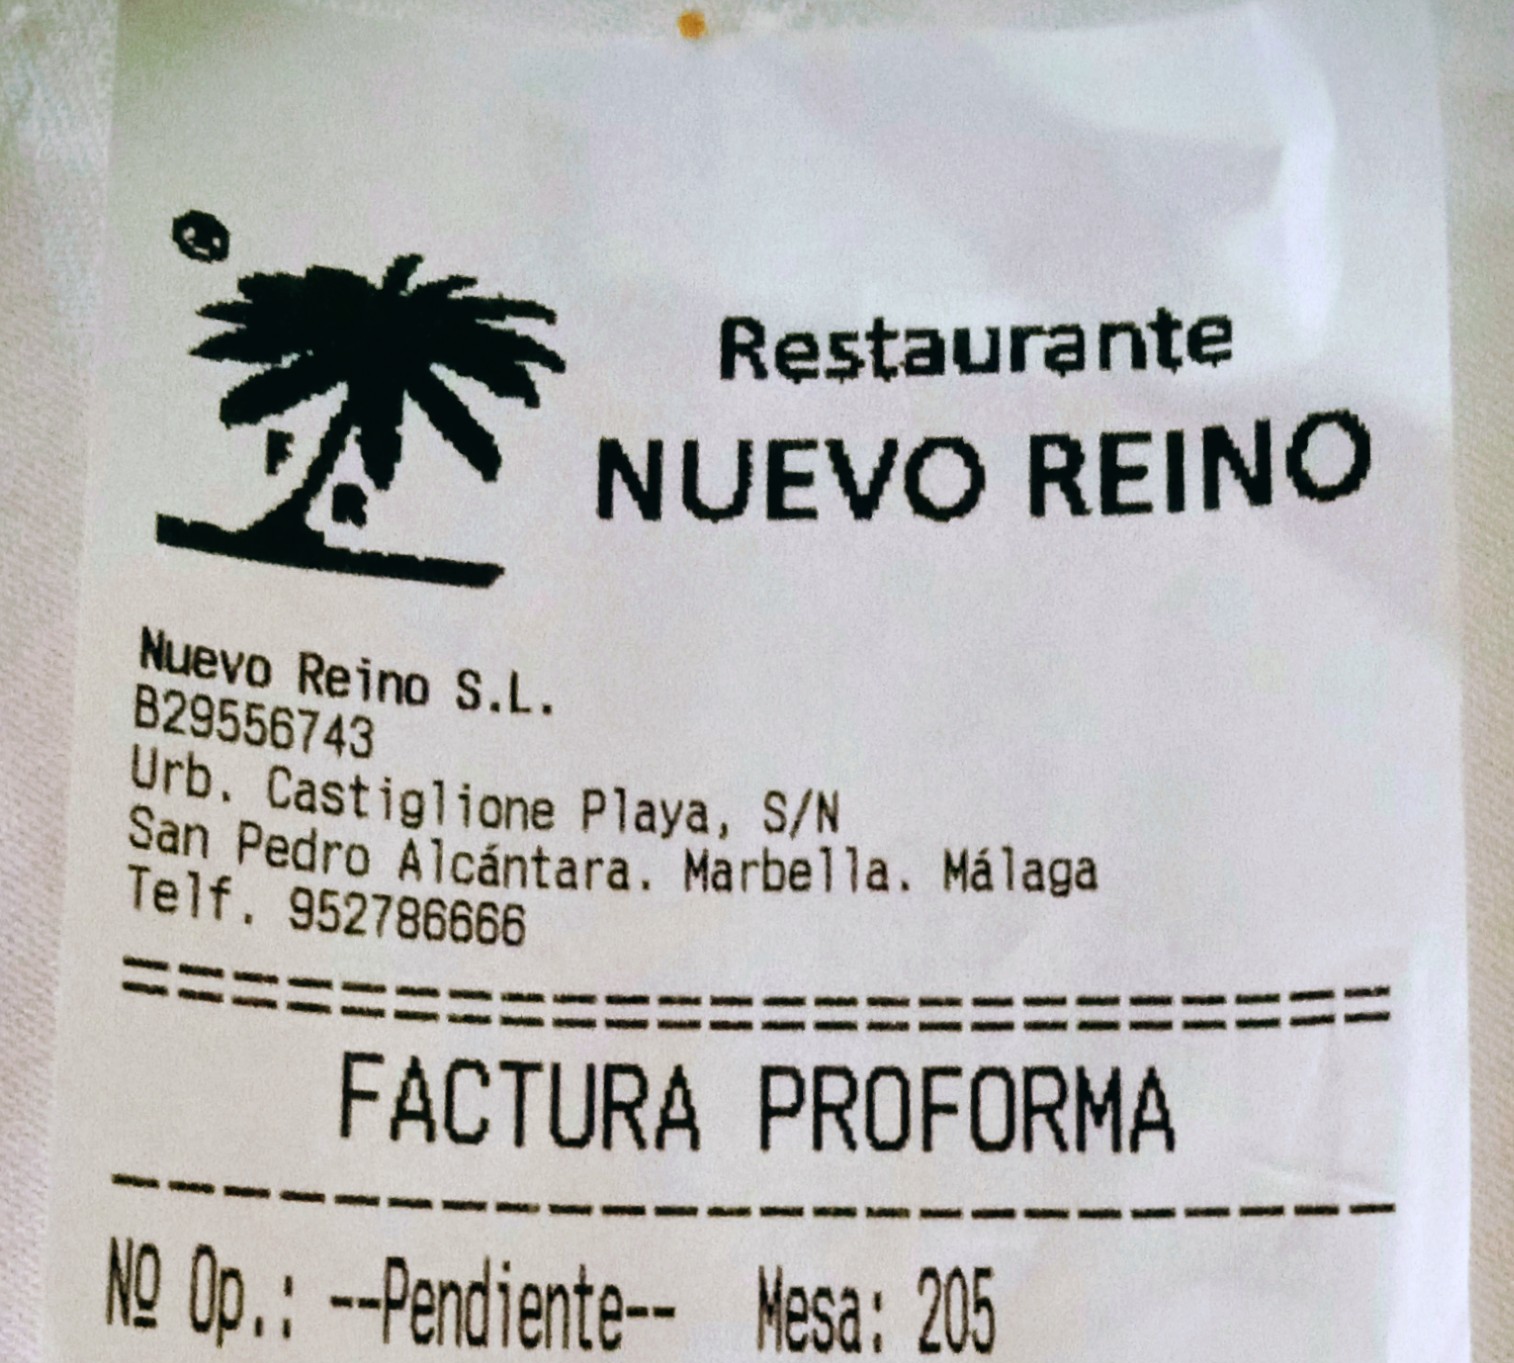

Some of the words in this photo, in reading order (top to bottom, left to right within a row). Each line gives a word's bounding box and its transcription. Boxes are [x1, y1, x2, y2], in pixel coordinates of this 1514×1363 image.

[718, 305, 1234, 386] Restaurante
[594, 434, 988, 526] NUEVO
[1027, 407, 1373, 520] REINO
[138, 624, 273, 690] Nuevo
[297, 650, 431, 708] Reino
[454, 667, 553, 717] S.L.
[133, 682, 375, 760] B29556743
[130, 742, 232, 803] Urb.
[266, 763, 556, 832] Castiglione
[581, 785, 729, 841] Playa,
[762, 787, 840, 841] S/N
[127, 803, 210, 860] San
[236, 818, 372, 878] Pedro
[397, 836, 651, 892] Alcántara.
[683, 844, 911, 894] Marbella.
[942, 844, 1100, 899] Málaga
[126, 862, 254, 926] Telf.
[288, 885, 527, 948] 952786666
[339, 1049, 702, 1153] FACTURA
[758, 1063, 1177, 1155] PROFORMA
[188, 1242, 294, 1349] Op.:
[756, 1264, 883, 1356] Mesa:
[916, 1264, 997, 1356] 205
